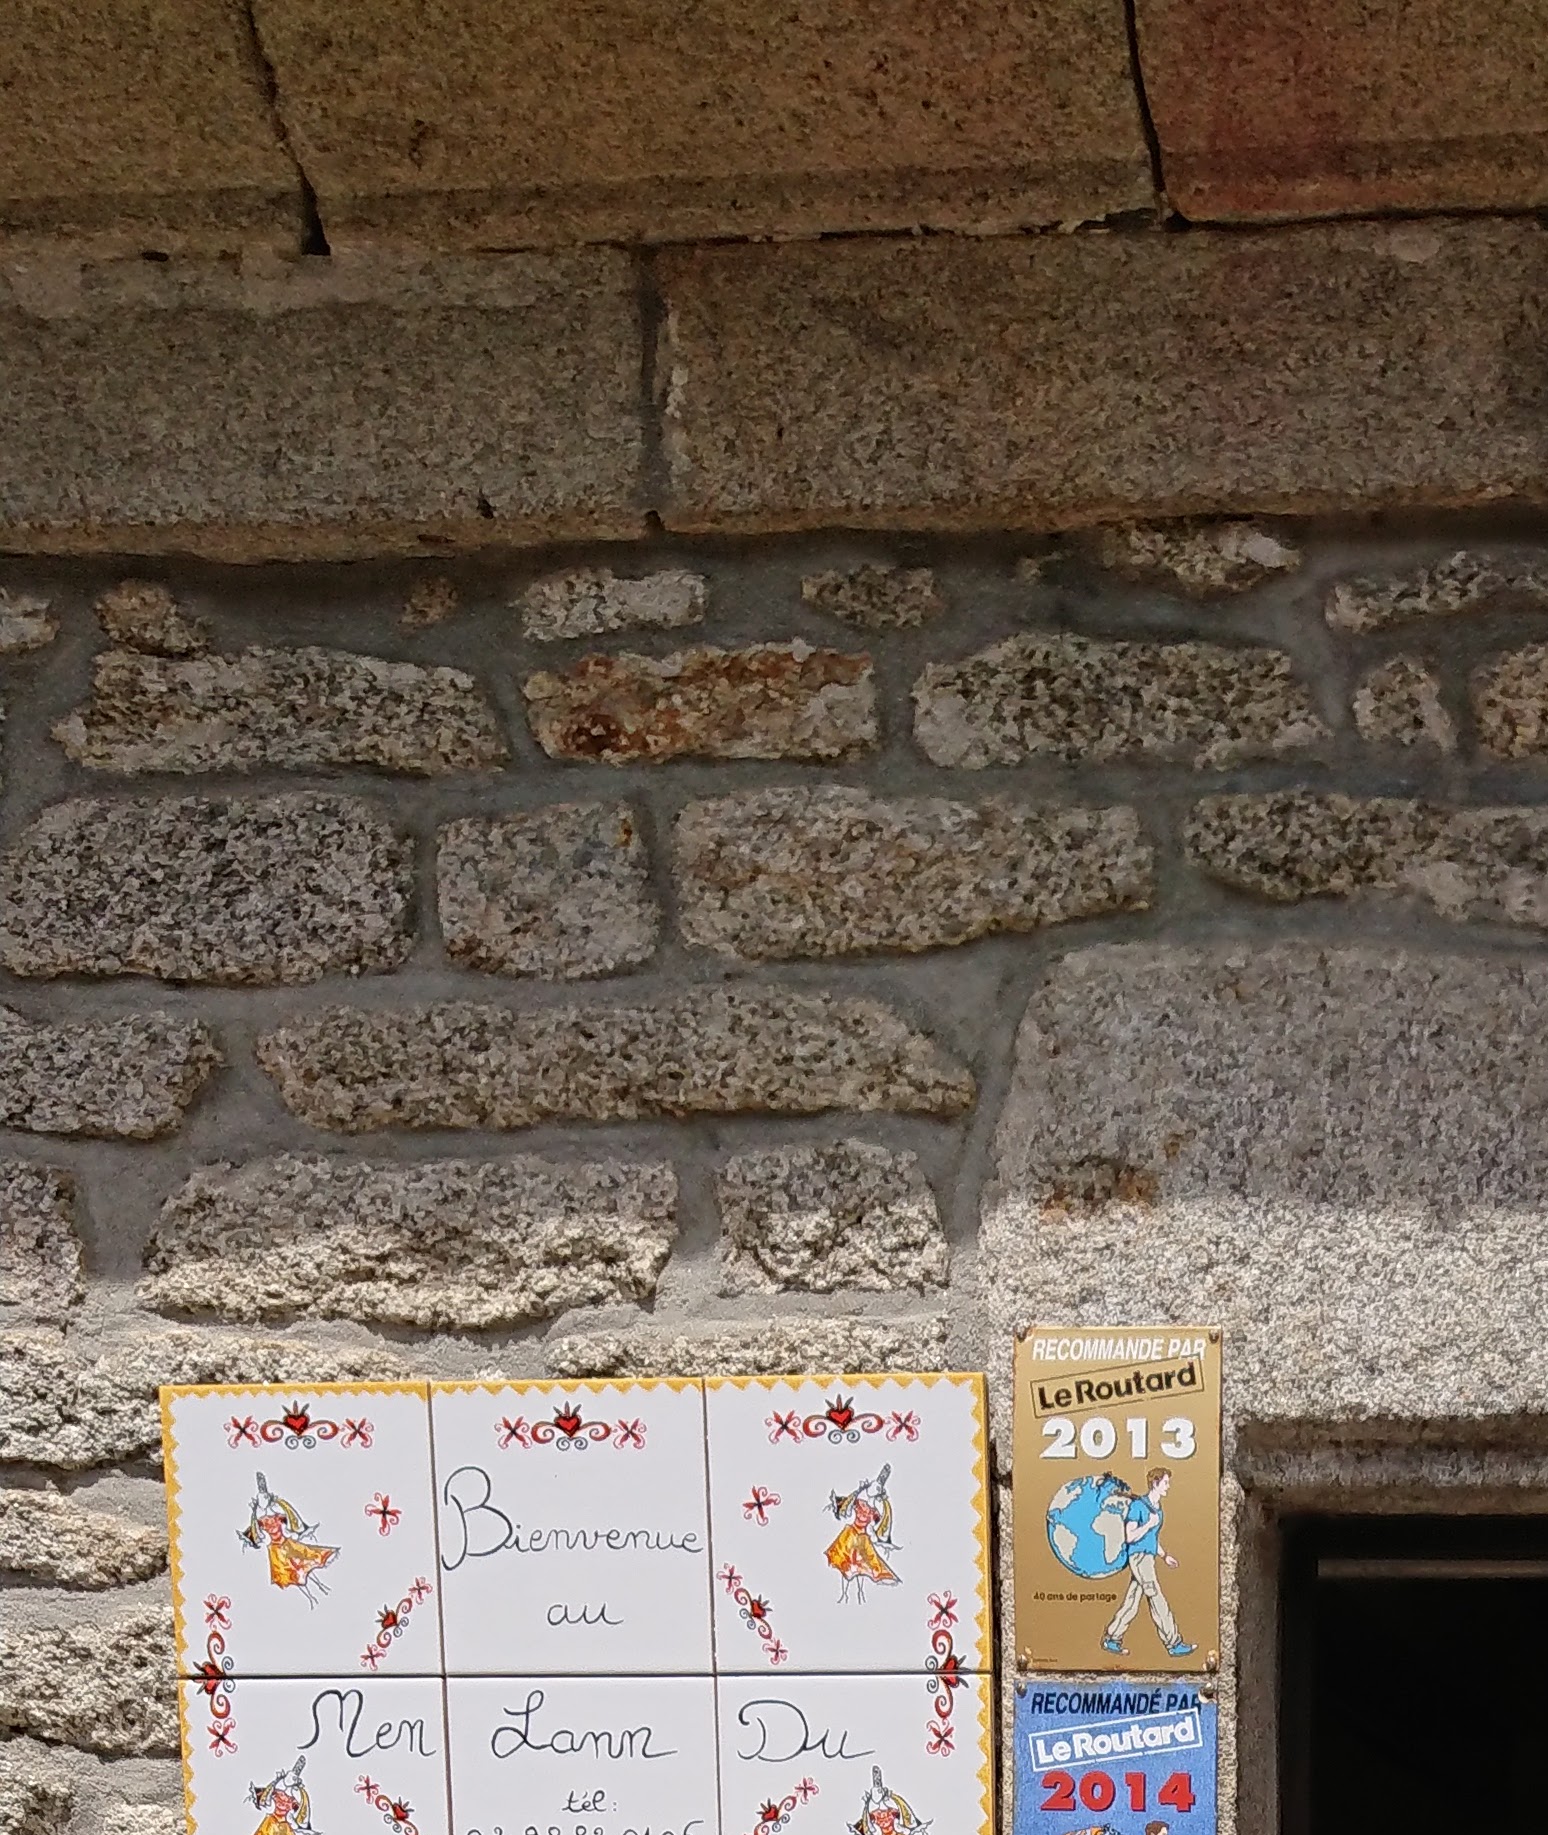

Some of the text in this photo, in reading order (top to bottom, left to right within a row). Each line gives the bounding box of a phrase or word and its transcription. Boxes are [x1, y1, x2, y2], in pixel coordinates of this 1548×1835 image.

[1167, 1338, 1206, 1360] PAR
[1039, 1417, 1196, 1460] 2013
[442, 1466, 704, 1571] Bienvenue
[547, 1603, 624, 1626] au
[1066, 1592, 1078, 1601] de
[1080, 1592, 1117, 1603] partage
[1031, 1688, 1162, 1715] RECOMMANDÉ
[297, 1688, 876, 1762] Men Lann Du
[1040, 1770, 1196, 1812] 2014
